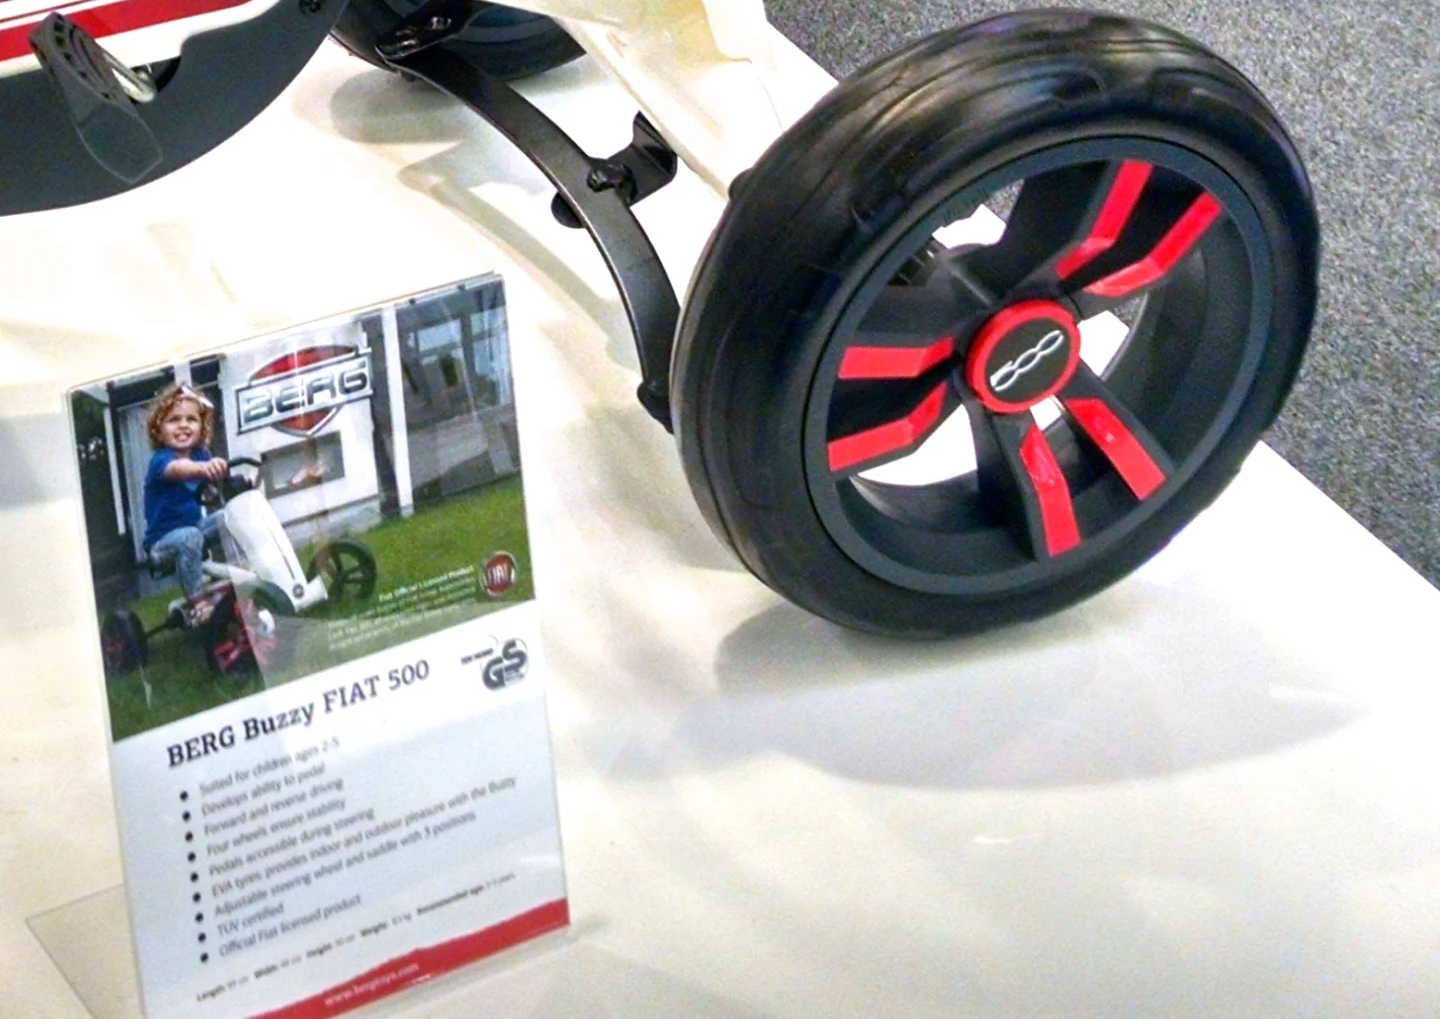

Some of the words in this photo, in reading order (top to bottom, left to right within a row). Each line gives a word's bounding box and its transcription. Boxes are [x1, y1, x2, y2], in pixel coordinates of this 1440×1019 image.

[243, 360, 369, 425] BERG
[482, 637, 527, 691] GS
[166, 724, 237, 769] BERG
[243, 701, 315, 742] Buzzy
[322, 674, 380, 714] FIAT
[388, 659, 430, 691] 500
[201, 791, 248, 817] Develops
[250, 779, 282, 799] ability
[283, 774, 295, 786] to
[297, 762, 326, 783] pedal
[235, 768, 250, 782] for
[252, 754, 292, 778] children
[295, 745, 319, 763] ages
[204, 811, 247, 836] Forward
[249, 803, 269, 821] and
[271, 792, 307, 813] reverse
[309, 778, 344, 799] driving
[207, 840, 230, 856] Four
[232, 826, 268, 847] wheels
[269, 813, 305, 833] ensure
[306, 798, 346, 820] stability
[209, 855, 244, 876] Pedals
[245, 836, 298, 863] accessible
[300, 824, 333, 844] during
[333, 808, 375, 830] steering
[212, 880, 233, 898] EVA
[235, 871, 262, 889] tyres
[265, 854, 308, 879] provides
[309, 840, 341, 860] indoor
[343, 831, 363, 848] and
[364, 818, 403, 840] outdoor
[404, 801, 446, 827] pleasure
[448, 792, 469, 810] with
[470, 787, 487, 801] the
[214, 889, 269, 918] Adjustable
[270, 873, 312, 896] steering
[313, 859, 343, 880] wheel
[345, 851, 364, 869] and
[366, 839, 398, 861] saddle
[400, 830, 423, 847] with
[432, 810, 477, 837] positions
[218, 933, 257, 958] Official
[258, 925, 279, 942] Fiat
[279, 908, 322, 933] licensed
[323, 893, 362, 920] product
[241, 901, 285, 929] certified
